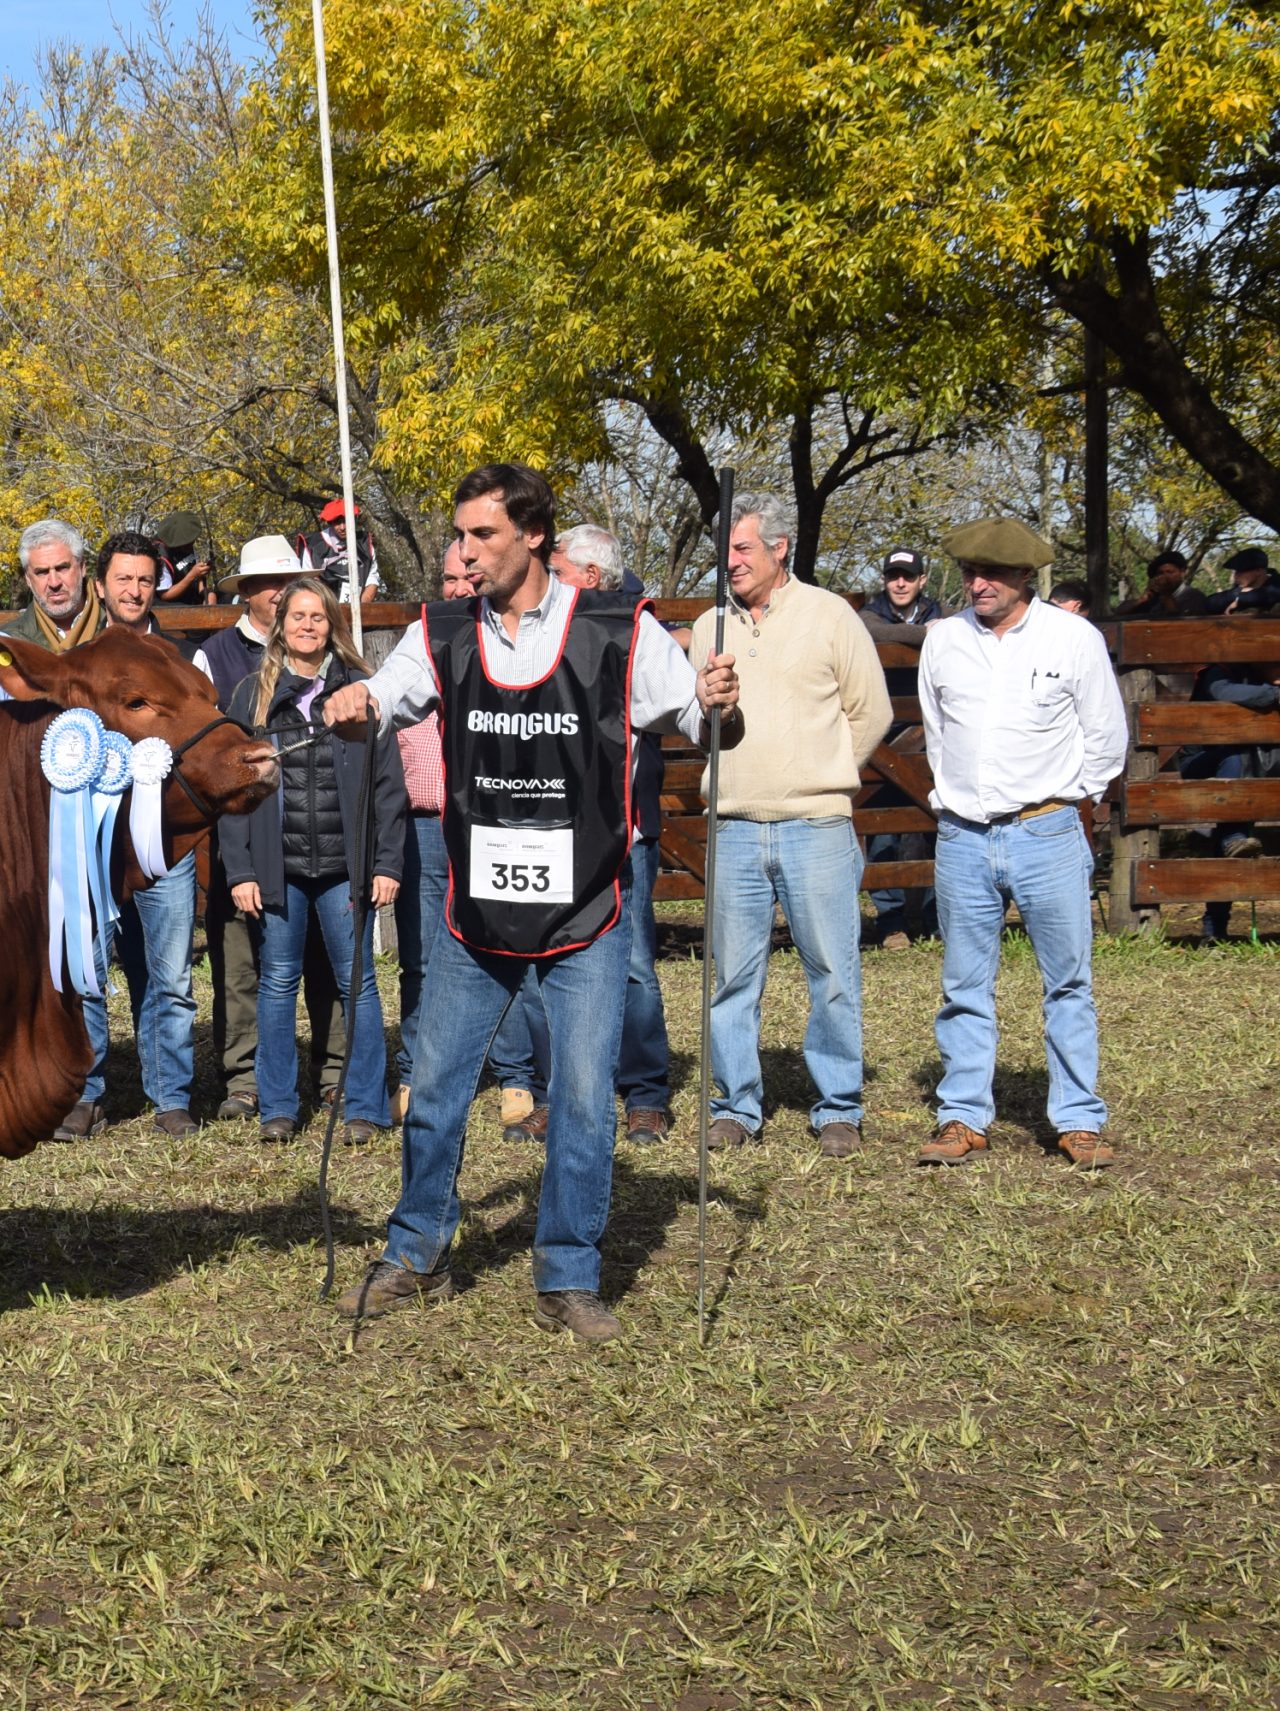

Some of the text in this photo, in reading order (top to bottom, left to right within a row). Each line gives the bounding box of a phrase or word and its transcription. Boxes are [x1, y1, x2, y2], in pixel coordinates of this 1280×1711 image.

[468, 710, 579, 740] BRANGUS
[475, 776, 566, 790] TECNOVAX
[491, 863, 551, 893] 353
